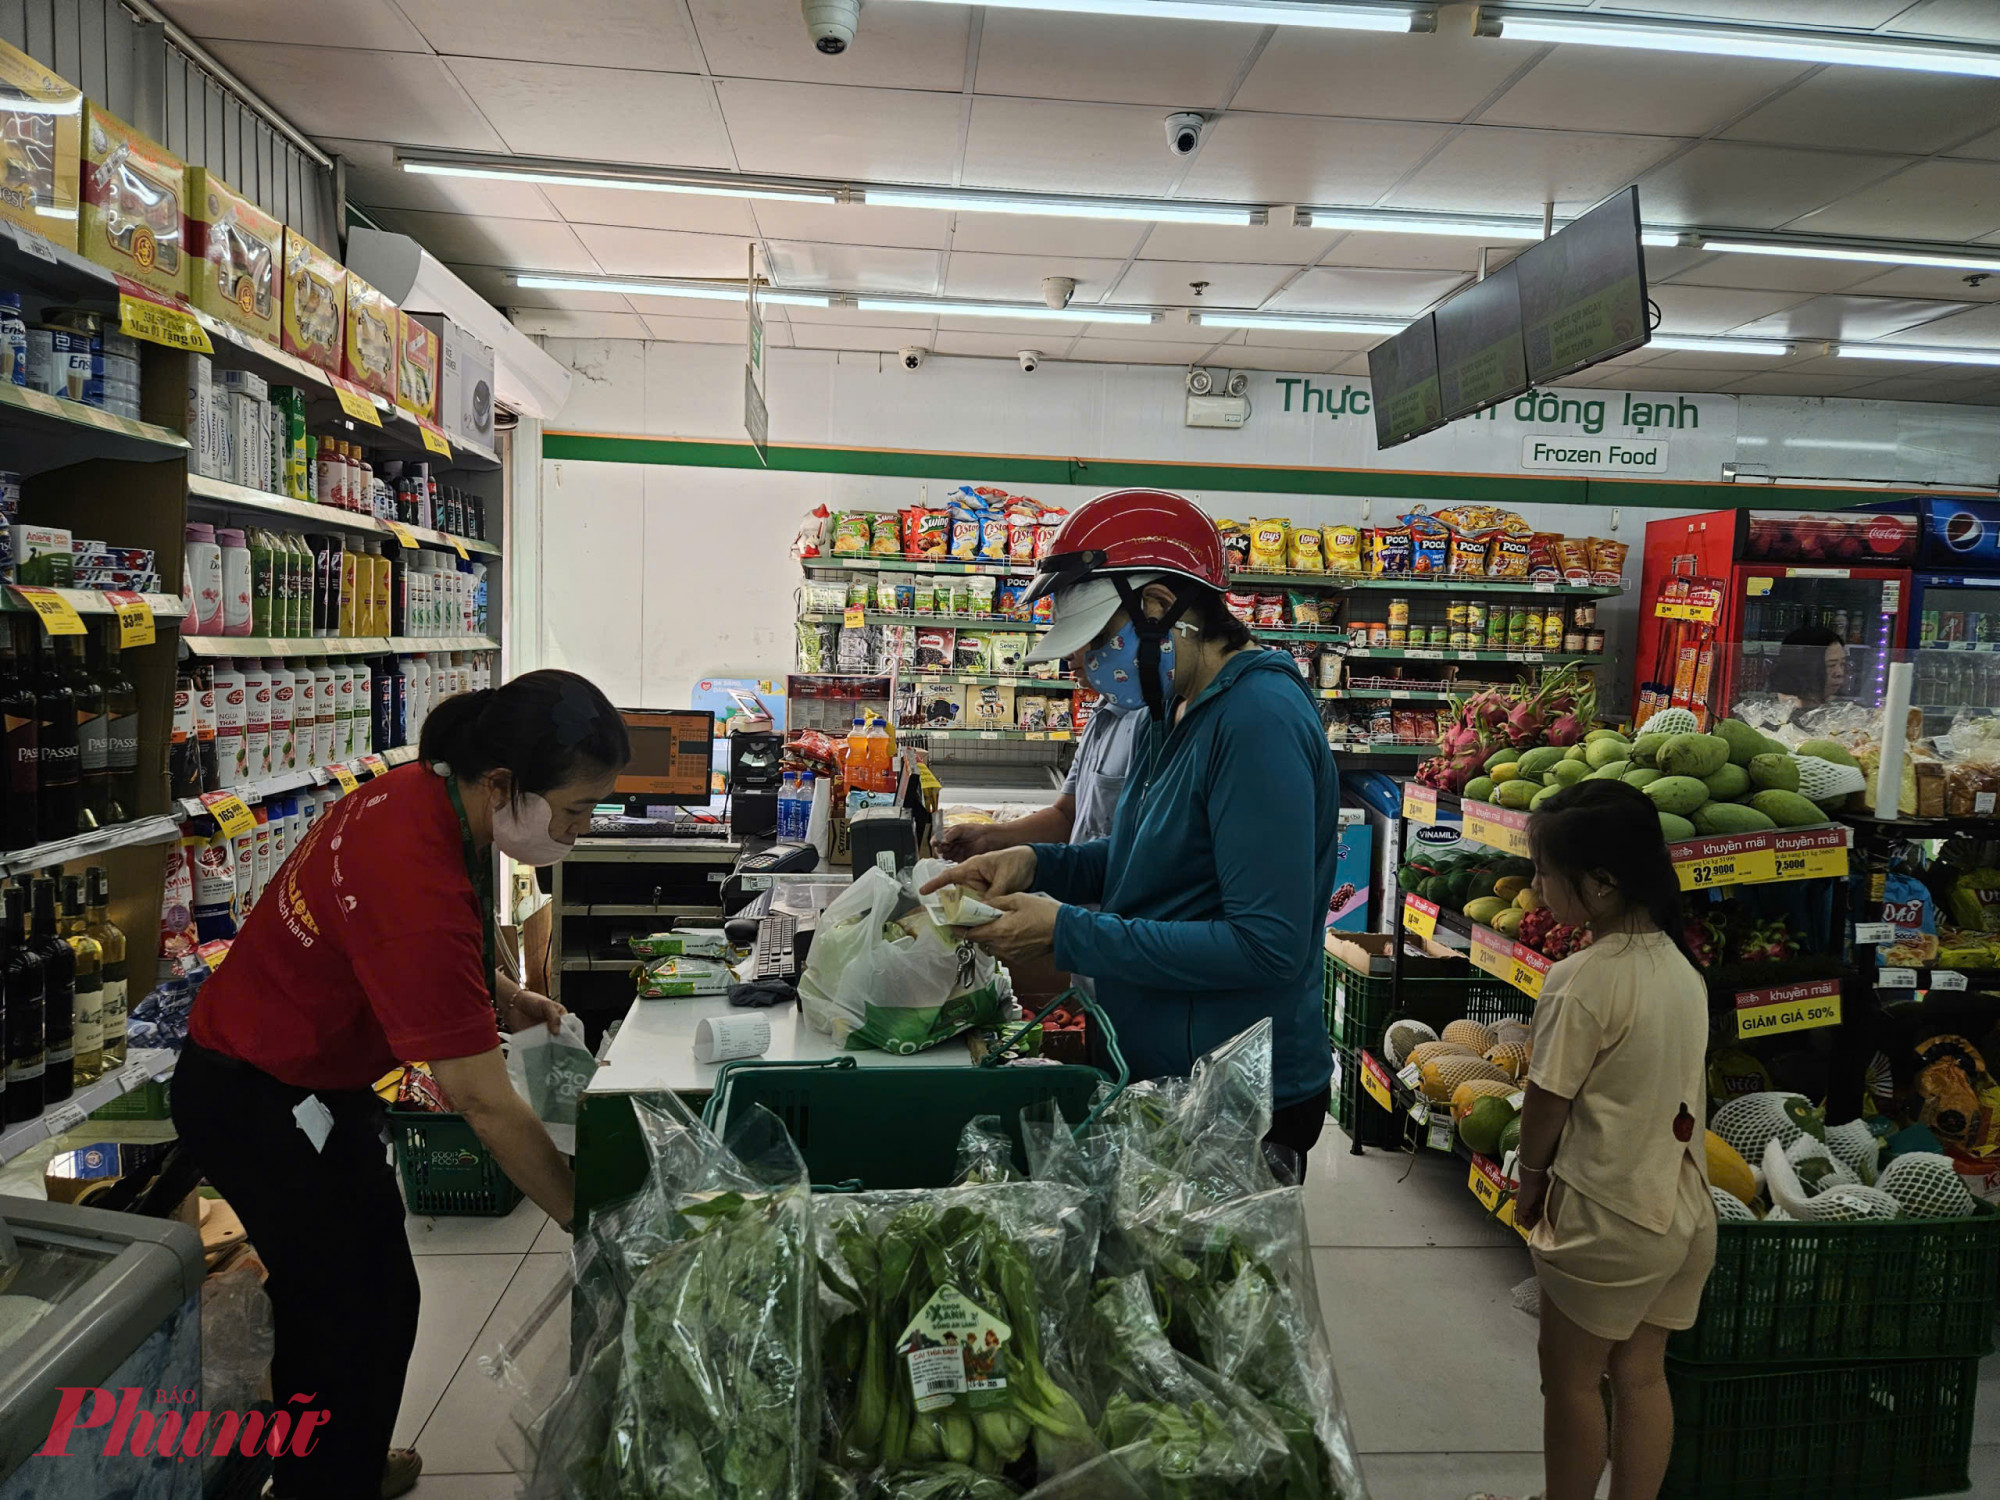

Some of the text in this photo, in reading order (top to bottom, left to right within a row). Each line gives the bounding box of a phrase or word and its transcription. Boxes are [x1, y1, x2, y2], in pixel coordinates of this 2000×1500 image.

[163, 328, 188, 346] Tặng
[191, 335, 203, 347] 01
[1514, 388, 1604, 434] đông
[1623, 392, 1698, 434] lạnh
[1533, 444, 1657, 466] Frozen Food
[918, 515, 949, 534] Swing
[1259, 530, 1281, 543] Lay's
[1300, 534, 1319, 544] Lay's
[1336, 533, 1354, 545] Lay's
[1385, 535, 1409, 545] POCA
[1421, 540, 1446, 550] POCA
[1459, 541, 1485, 552] POCA
[1502, 542, 1526, 552] POCA
[929, 684, 953, 692] Select
[1419, 830, 1459, 840] VINAMILK
[1776, 833, 1840, 850] khuyến mãi
[1703, 836, 1767, 855] khuyến mãi
[286, 918, 315, 948] hàng
[1769, 982, 1832, 1002] khuyến mãi
[1742, 1006, 1835, 1030] GIẢM GIÁ 50%
